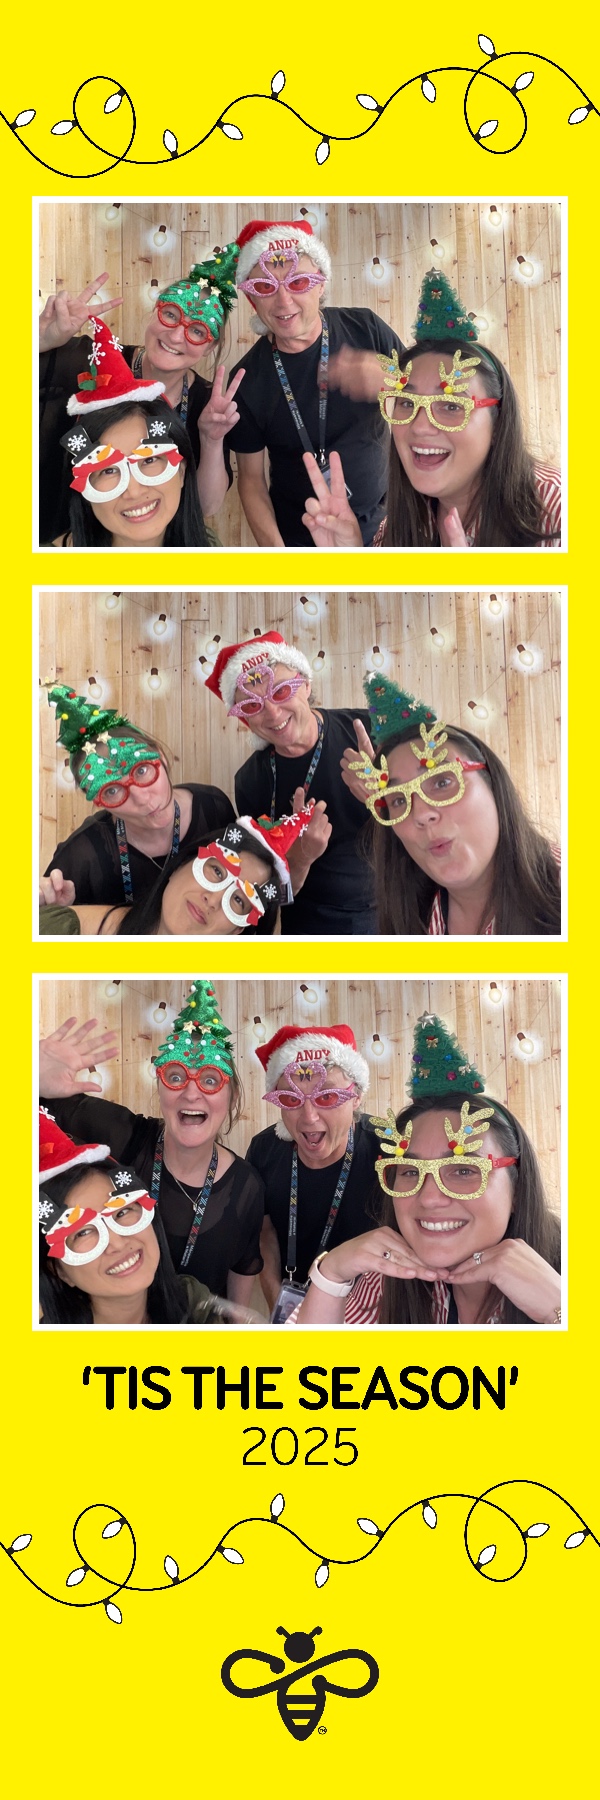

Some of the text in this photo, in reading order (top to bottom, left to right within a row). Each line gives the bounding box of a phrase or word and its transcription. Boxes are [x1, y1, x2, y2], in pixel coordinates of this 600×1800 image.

[268, 239, 299, 252] ANDY
[241, 652, 270, 673] ANDY
[295, 1049, 331, 1063] ANDY
